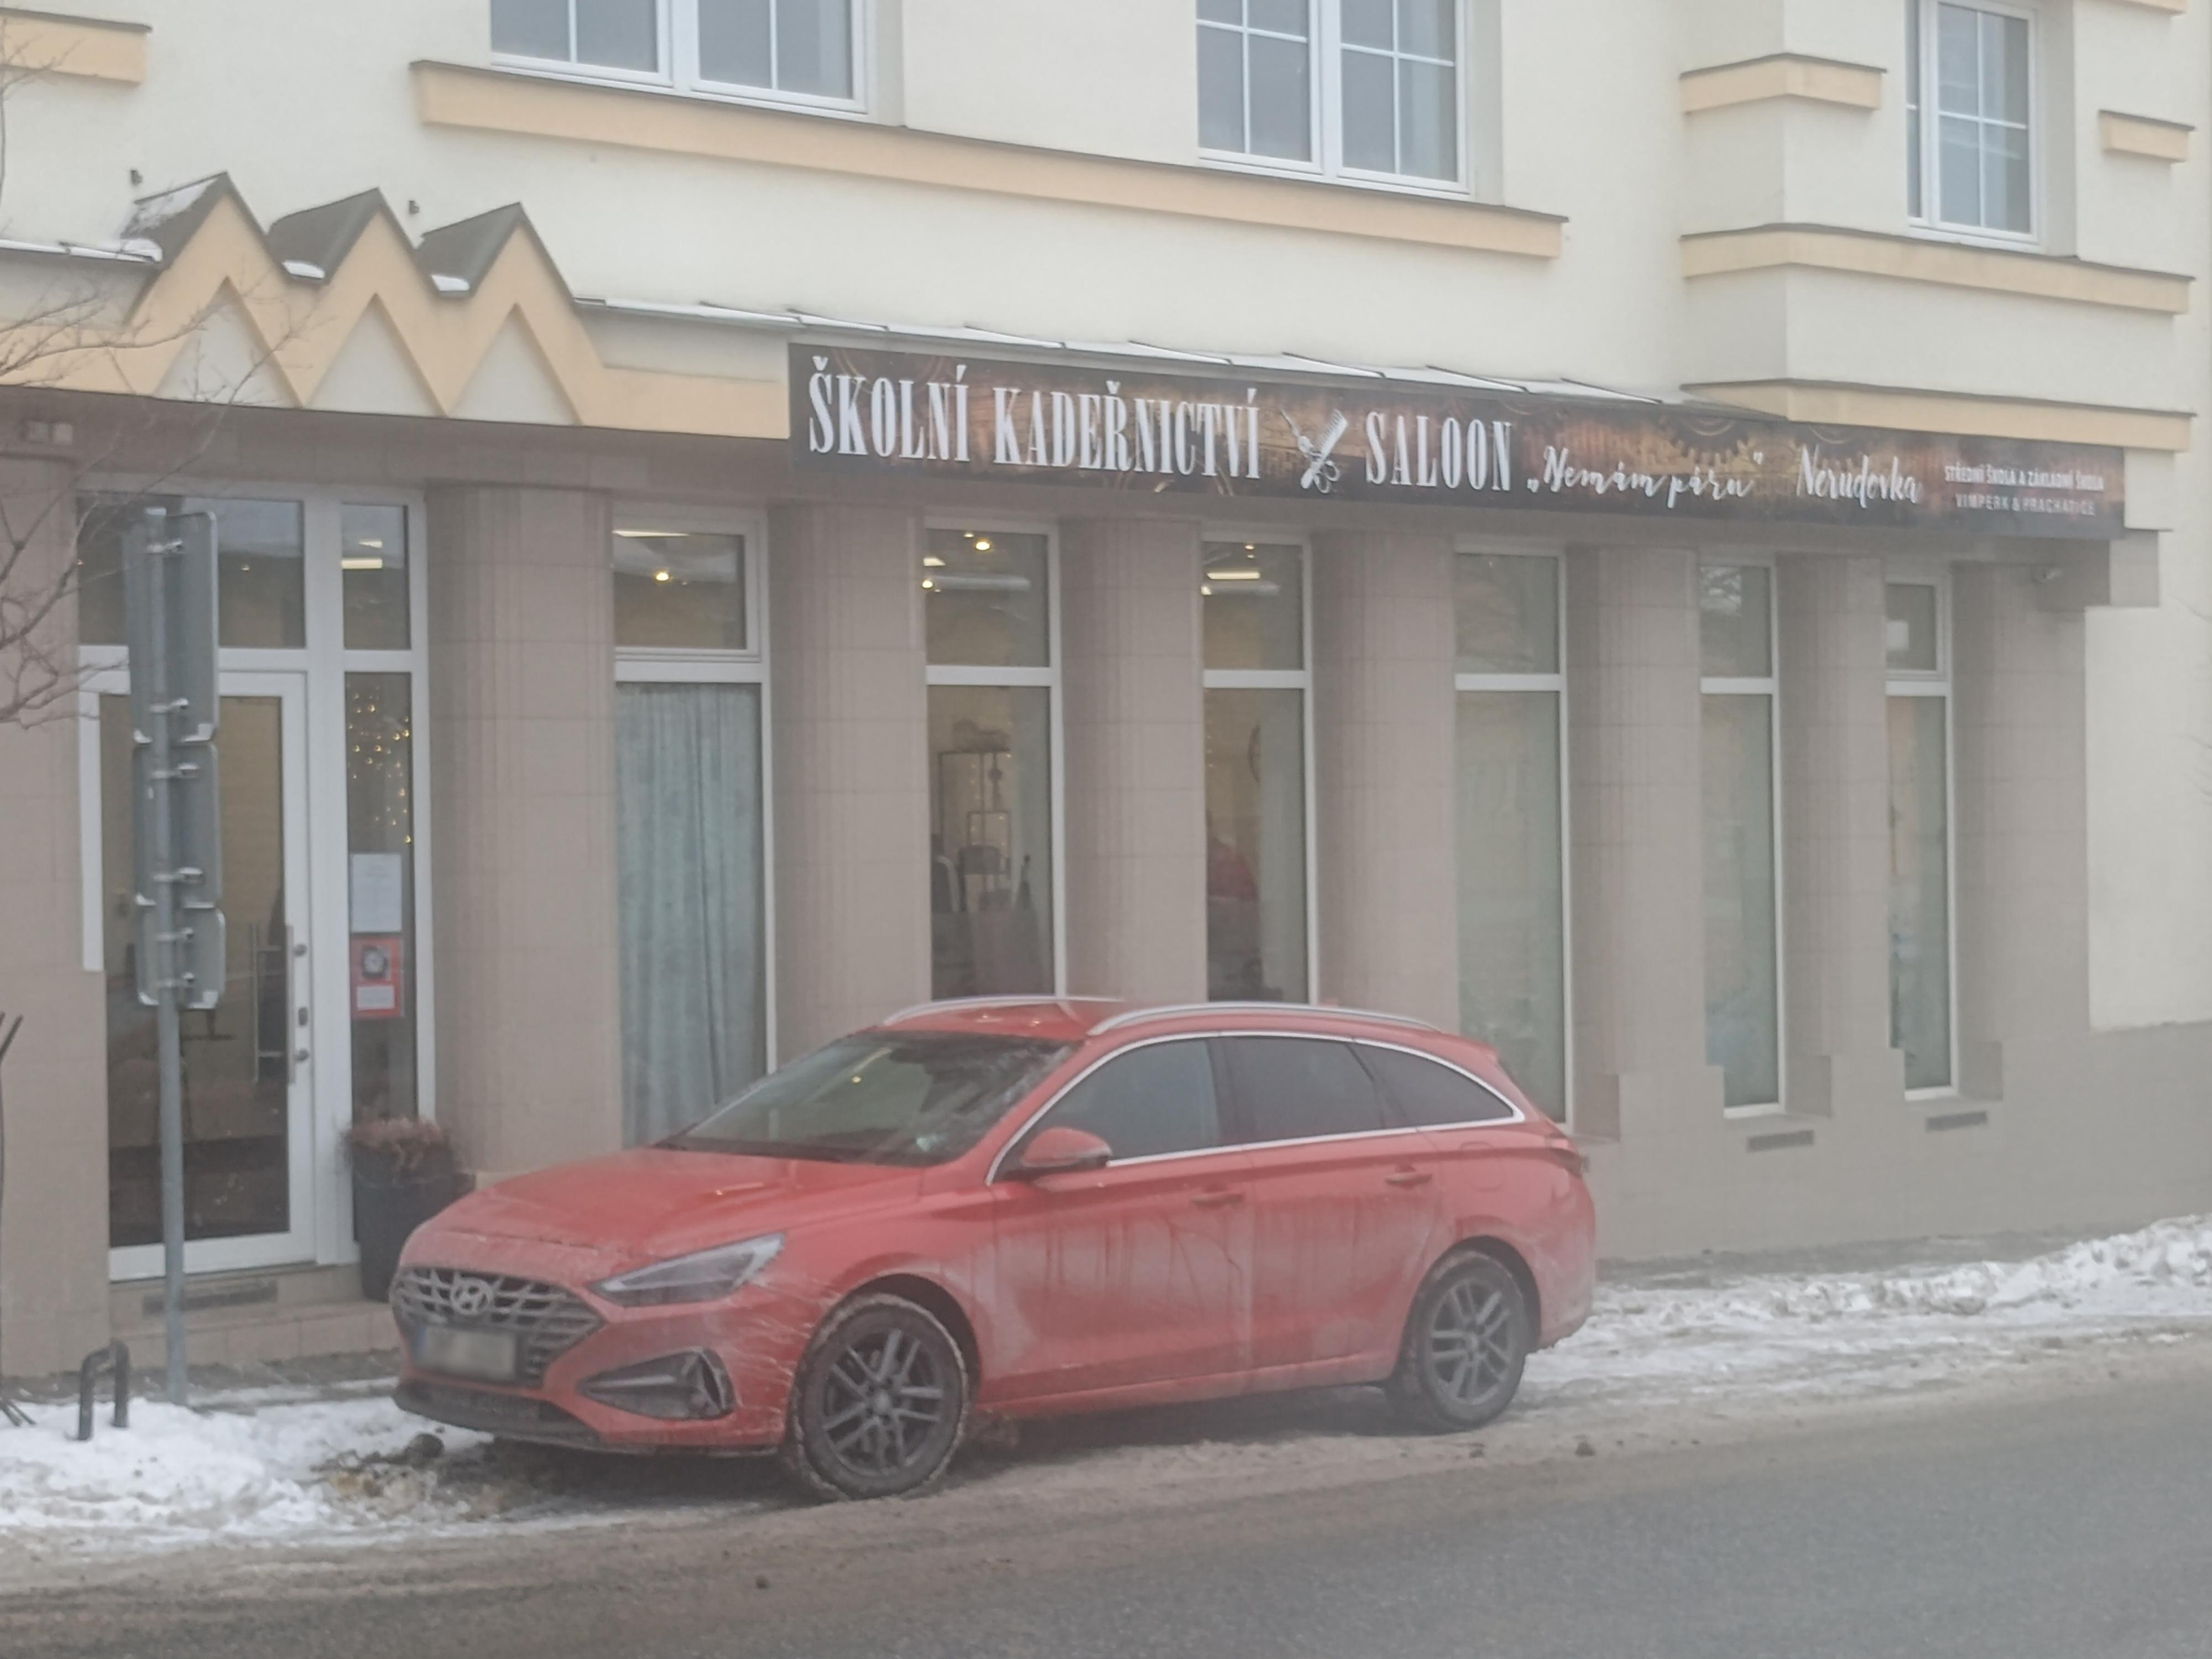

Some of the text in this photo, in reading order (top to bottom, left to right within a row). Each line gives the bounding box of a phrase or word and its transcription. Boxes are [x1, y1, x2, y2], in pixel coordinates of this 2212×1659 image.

[809, 356, 1512, 491] ŠKOLNÍ KADEŘNICTVÍ SALOON
[1797, 444, 1923, 509] Nerudovka
[1955, 493, 2009, 510] VIMPERK
